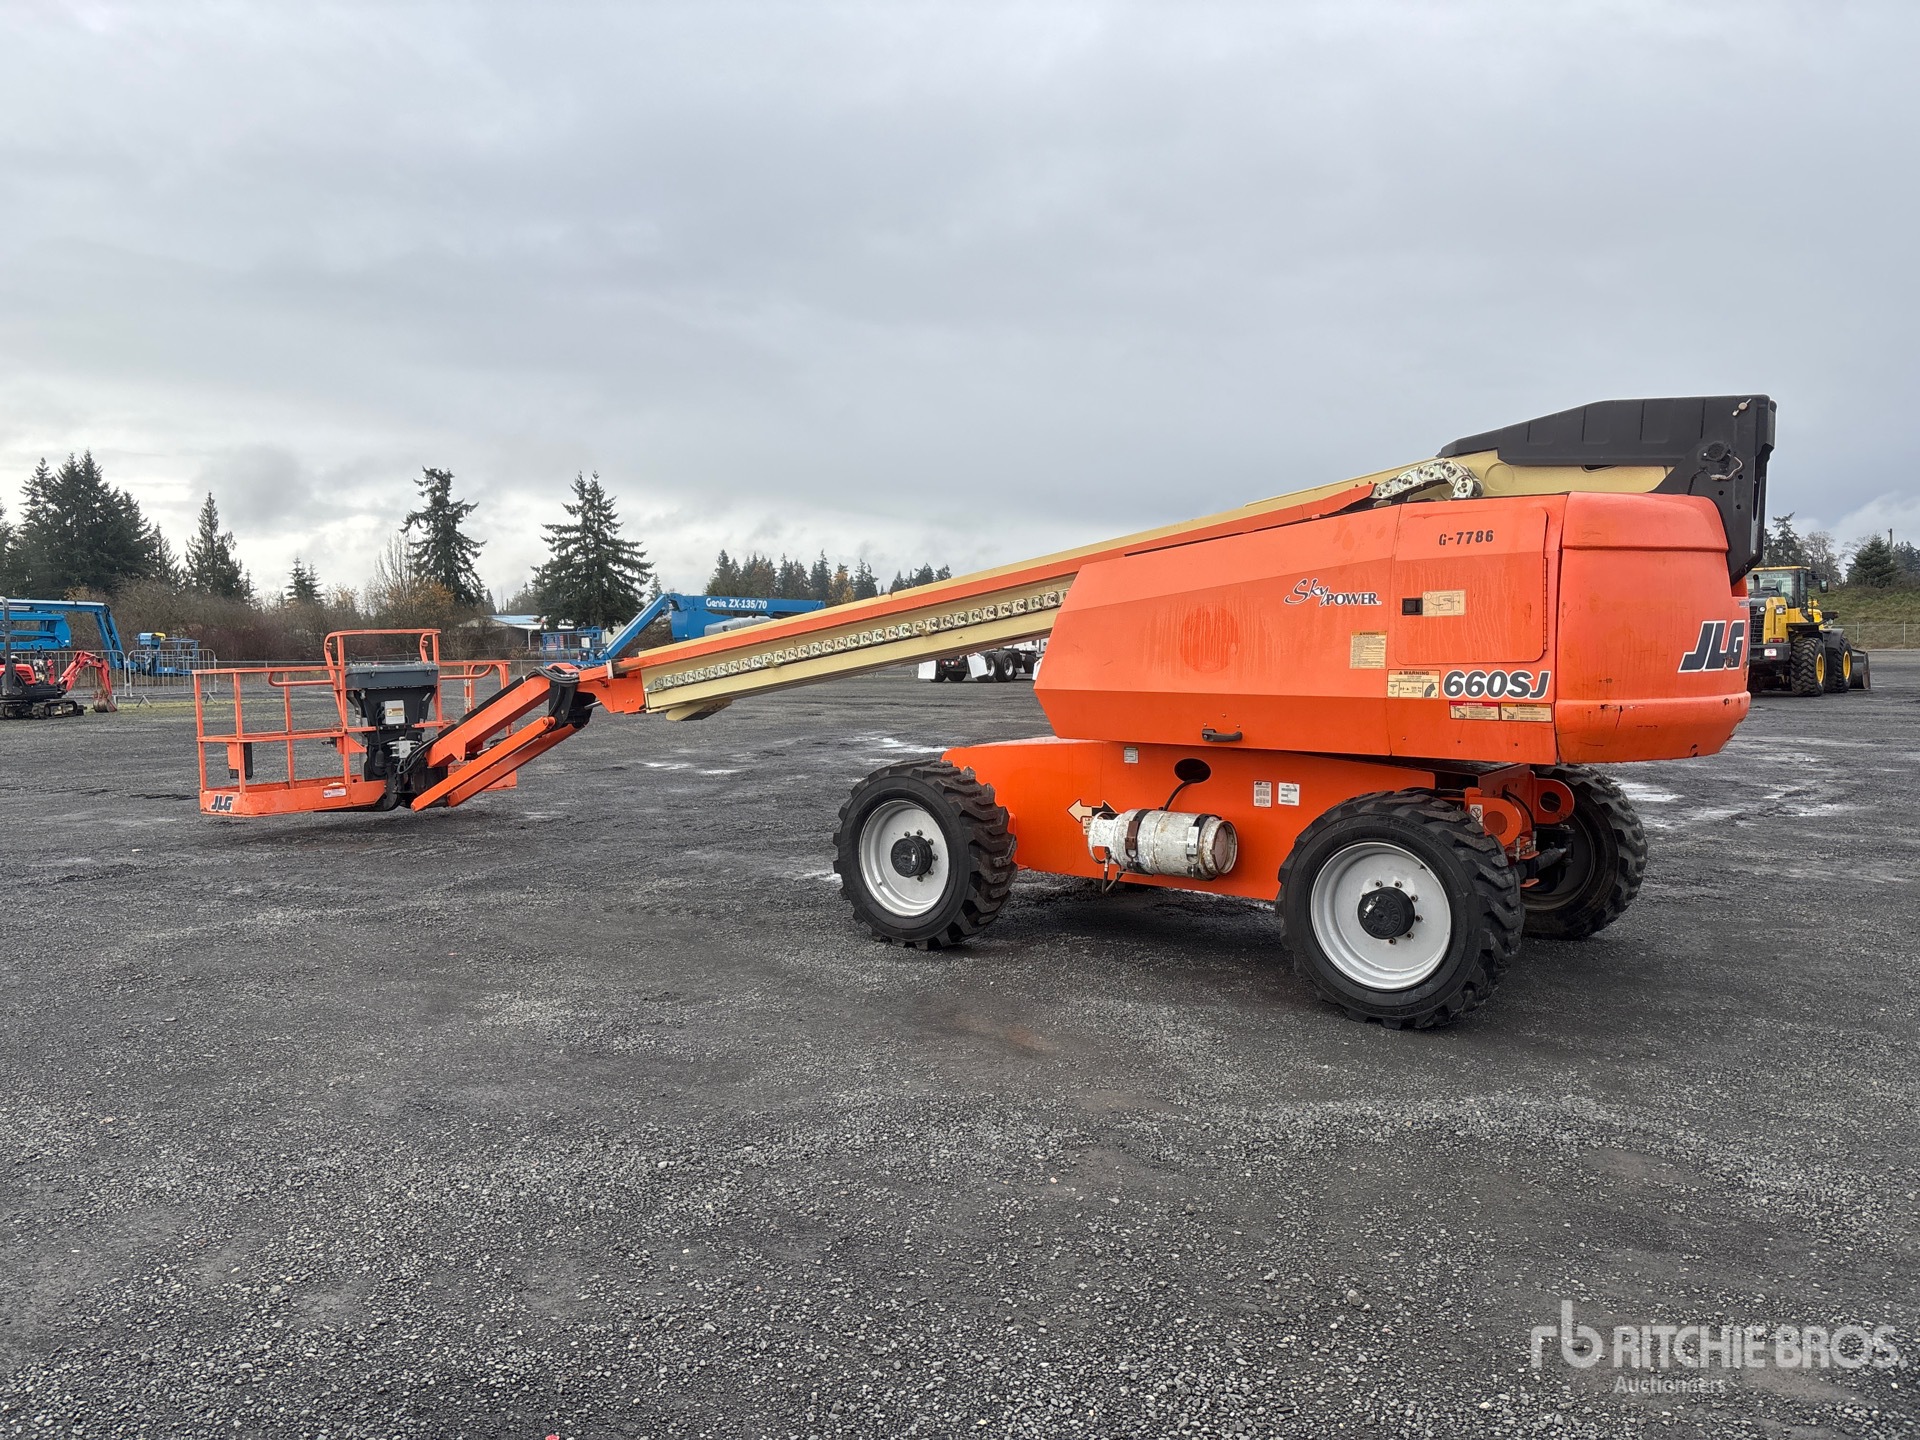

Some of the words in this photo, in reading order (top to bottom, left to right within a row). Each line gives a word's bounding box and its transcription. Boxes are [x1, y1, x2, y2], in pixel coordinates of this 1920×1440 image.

[1439, 529, 1494, 546] G-7786
[705, 597, 727, 608] Genie
[728, 598, 768, 610] ZX-135/70
[1284, 578, 1329, 607] Sky
[1325, 592, 1379, 606] POWER
[1678, 620, 1745, 673] JLG
[1442, 669, 1551, 699] 660SJ
[211, 795, 234, 811] JLG
